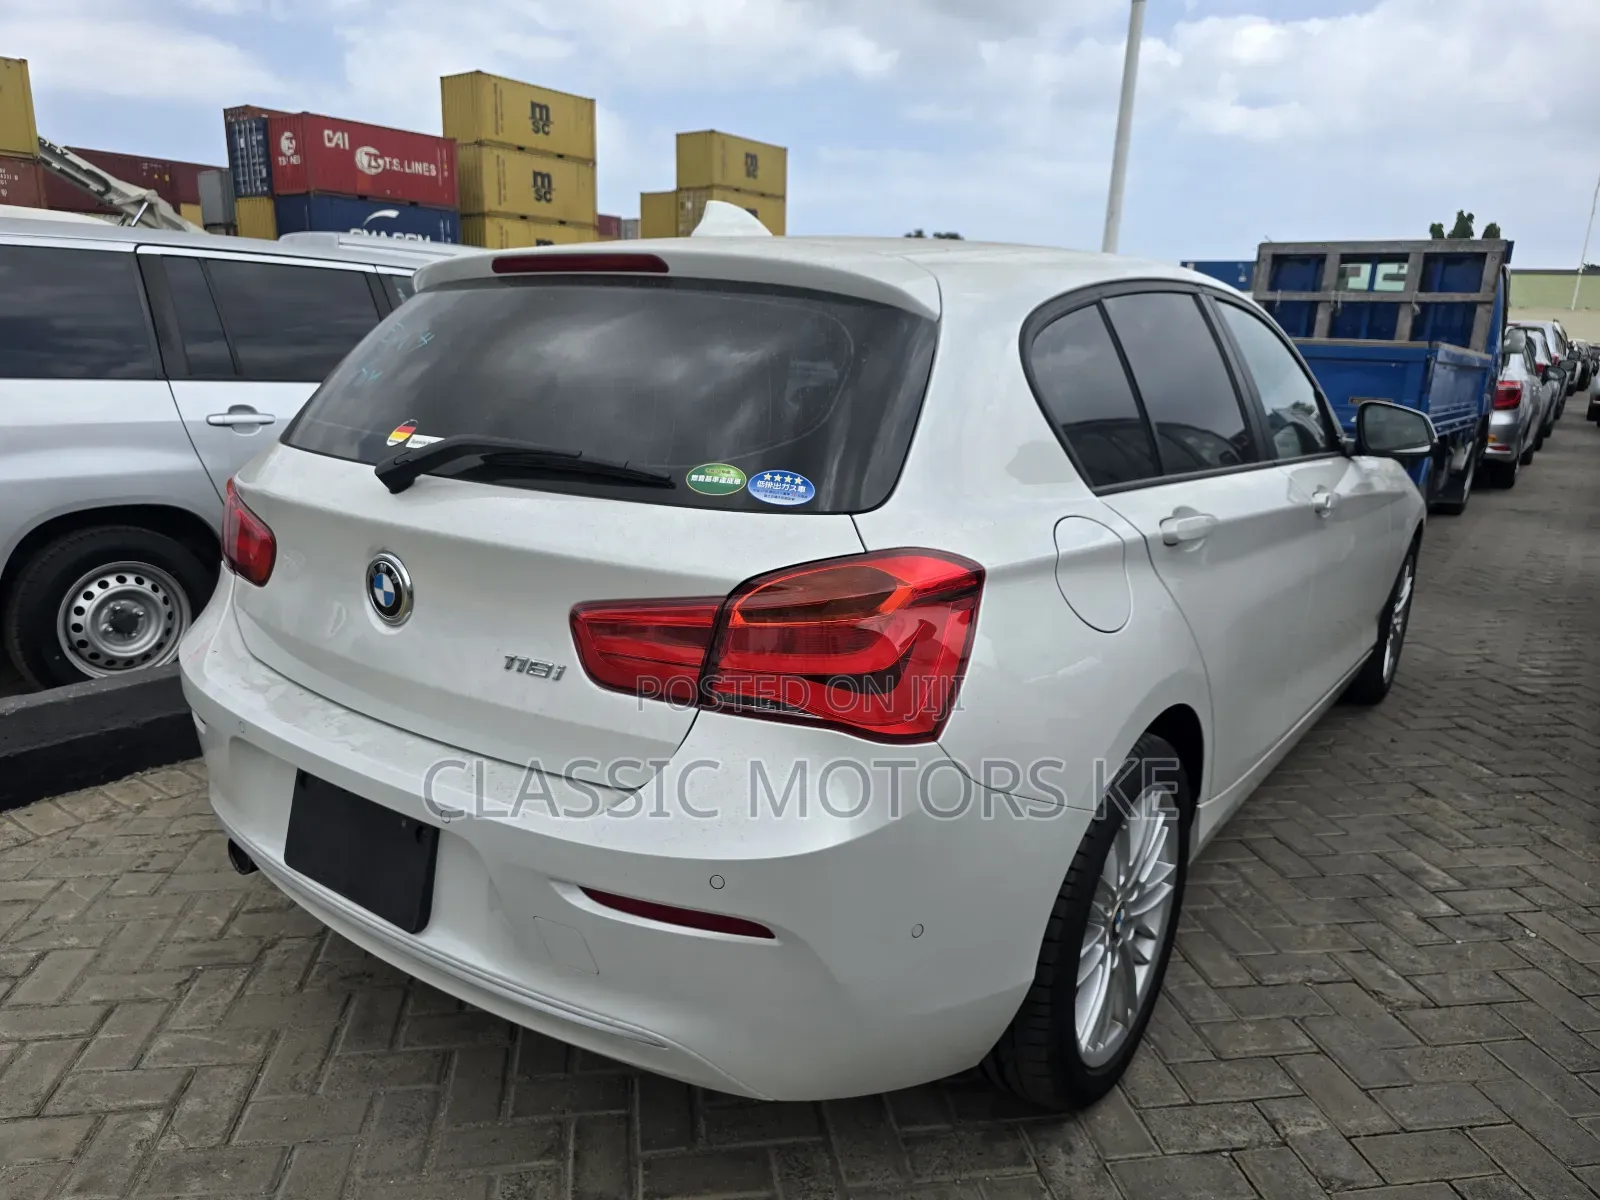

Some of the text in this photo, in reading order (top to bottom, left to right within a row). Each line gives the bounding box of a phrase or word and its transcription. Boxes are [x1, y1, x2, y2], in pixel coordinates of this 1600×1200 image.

[323, 129, 349, 150] CAI
[405, 160, 437, 177] LINES
[503, 653, 567, 682] 118i
